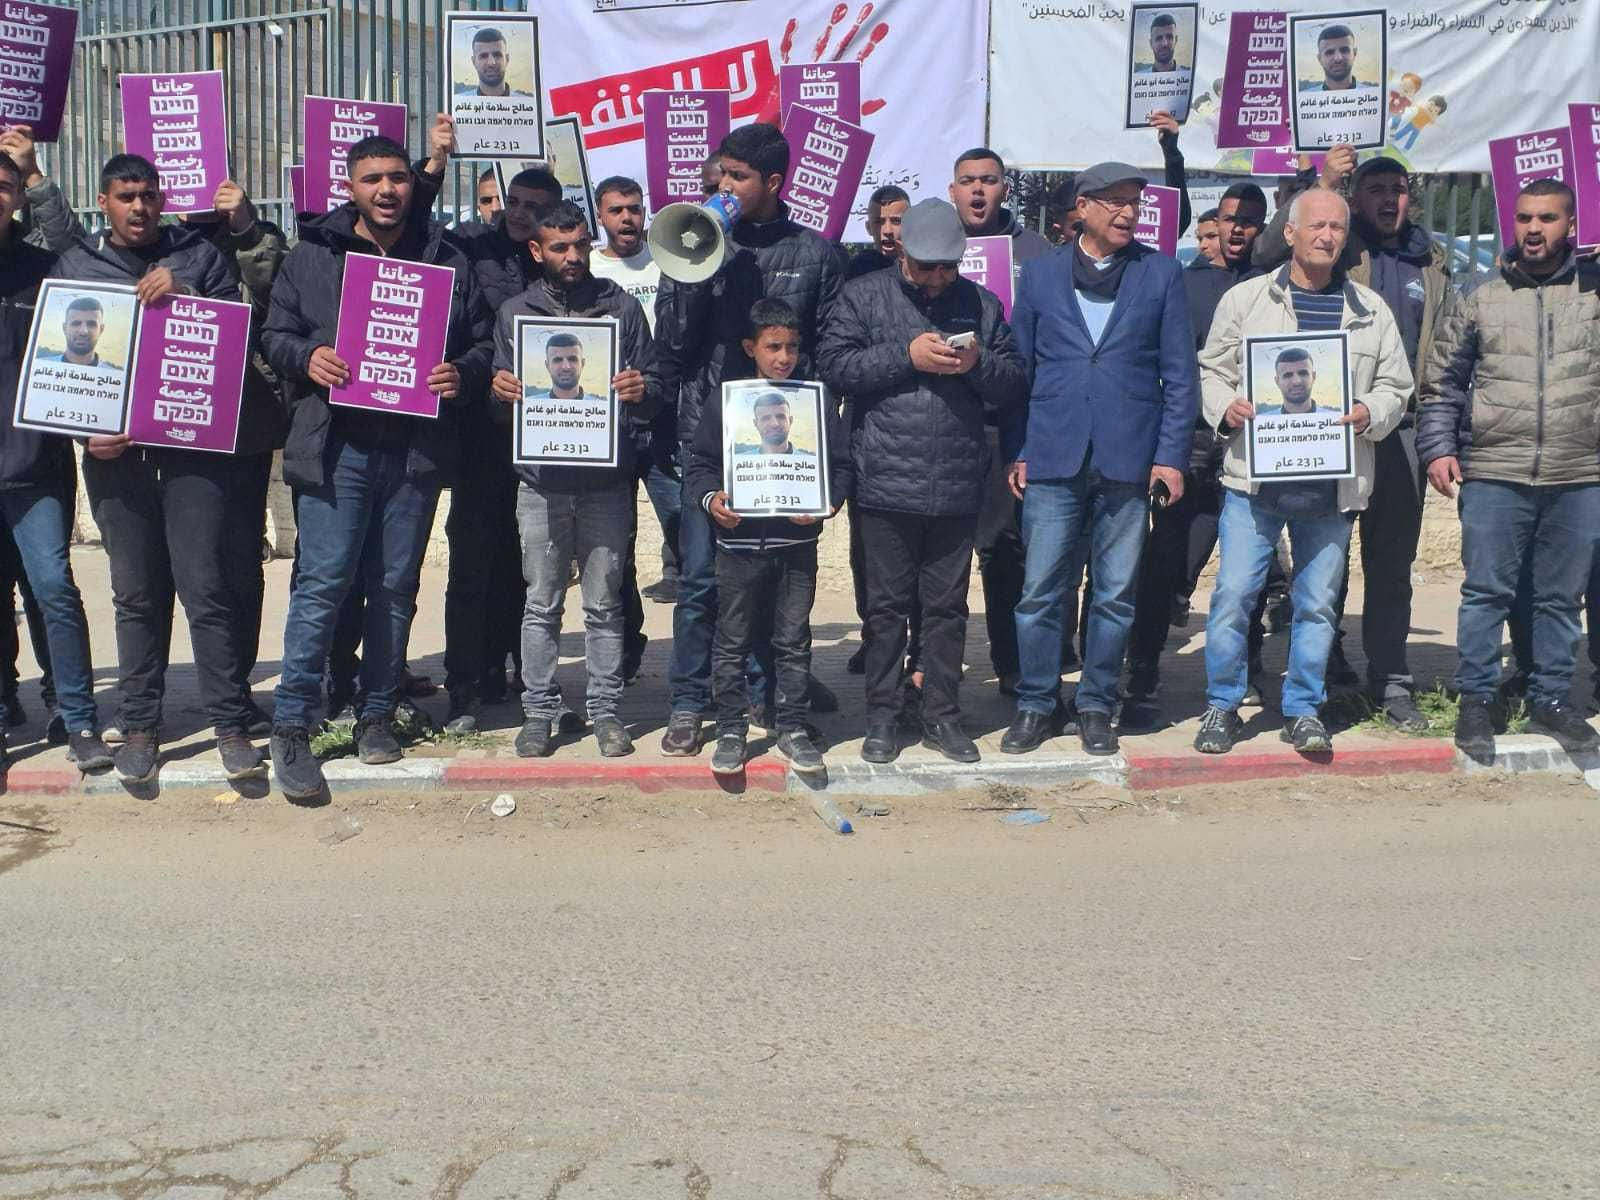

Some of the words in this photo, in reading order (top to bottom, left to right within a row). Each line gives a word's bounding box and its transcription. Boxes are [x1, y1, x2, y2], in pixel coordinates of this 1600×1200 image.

[4, 2, 48, 24] حياتنا
[1254, 16, 1286, 32] حياتنا
[3, 25, 45, 42] חיינו
[1252, 36, 1284, 48] חיינו
[1248, 52, 1284, 70] ليست
[0, 63, 40, 80] אינם
[802, 67, 836, 82] حياتنا
[1248, 72, 1280, 84] אינם
[0, 83, 42, 104] رخيص
[152, 79, 194, 96] حياتنا
[802, 84, 836, 97] חיינו
[154, 98, 194, 112] חיינו
[668, 94, 704, 110] حياتنا
[1242, 90, 1280, 106] رخيصة
[0, 102, 38, 118] הפק
[334, 104, 376, 124] حياتنا
[1241, 110, 1279, 125] הפקר
[152, 114, 198, 132] ليست
[670, 114, 704, 125] חיינו
[668, 128, 707, 144] ليست
[814, 117, 850, 141] حياتنا
[1352, 132, 1362, 142] בן
[158, 135, 196, 148] אינם
[474, 138, 490, 151] عام
[494, 141, 506, 150] 23
[510, 140, 520, 151] בן
[1318, 132, 1332, 144] عام
[1336, 133, 1348, 142] 23
[1516, 136, 1558, 152] حياتنا
[672, 147, 704, 158] אינם
[808, 137, 844, 158] חיינו
[154, 153, 203, 170] رخيصة
[800, 155, 841, 177] ليست
[1520, 153, 1558, 170] חיינו
[668, 162, 702, 178] خيصة
[670, 182, 703, 194] פקר
[798, 172, 832, 193] אינם
[788, 185, 830, 214] رخيصة
[788, 206, 824, 229] הפק
[378, 262, 422, 284] حياتنا
[376, 285, 419, 303] חיינו
[172, 300, 217, 322] حياتنا
[370, 306, 419, 326] ليست
[170, 322, 214, 340] חיינו
[372, 326, 414, 344] אינם
[164, 344, 215, 364] ليست
[364, 342, 415, 368] رخيصة
[167, 364, 210, 380] אינם
[363, 366, 412, 384] הפקר
[159, 381, 212, 406] رخيصة
[46, 406, 65, 420] عام
[69, 411, 83, 422] 23
[86, 414, 98, 424] בן
[158, 404, 208, 423] הפקר
[542, 441, 560, 454] عام
[563, 444, 576, 454] 23
[579, 444, 589, 454] בן
[1275, 456, 1293, 470] عام
[1297, 458, 1310, 467] 23
[1314, 457, 1325, 468] בן
[754, 494, 771, 507] عام
[774, 496, 787, 504] 23
[790, 496, 801, 506] בן
